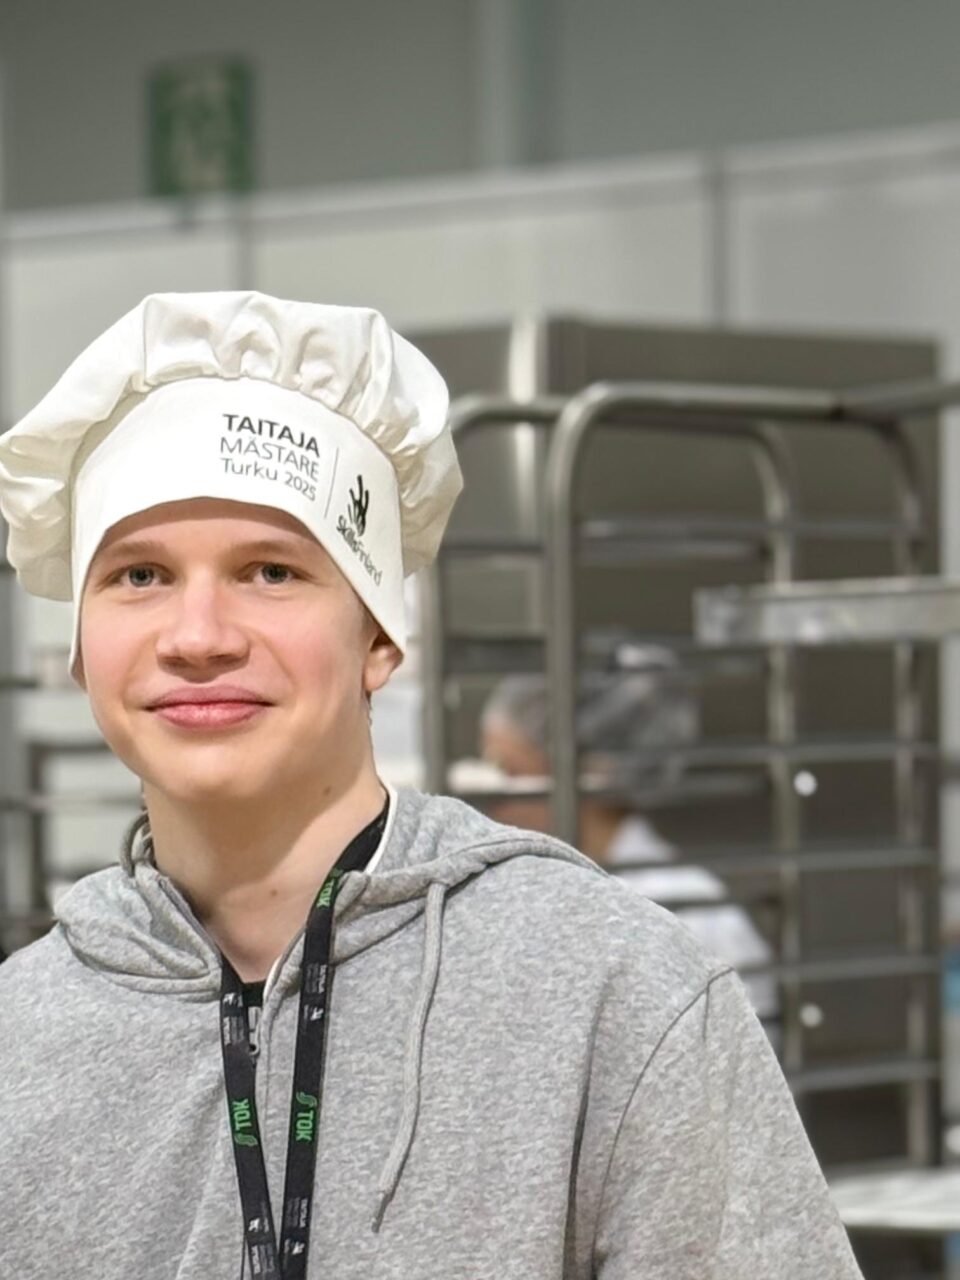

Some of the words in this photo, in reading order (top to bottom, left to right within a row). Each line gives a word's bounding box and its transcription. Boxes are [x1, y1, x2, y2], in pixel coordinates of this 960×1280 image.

[222, 413, 321, 459] TAITAJA
[219, 435, 320, 483] MÄSTARE
[220, 457, 278, 481] Turku
[284, 471, 317, 501] 2025
[316, 879, 335, 908] TOK
[232, 1098, 252, 1131] TOK
[296, 1110, 314, 1141] TOK
